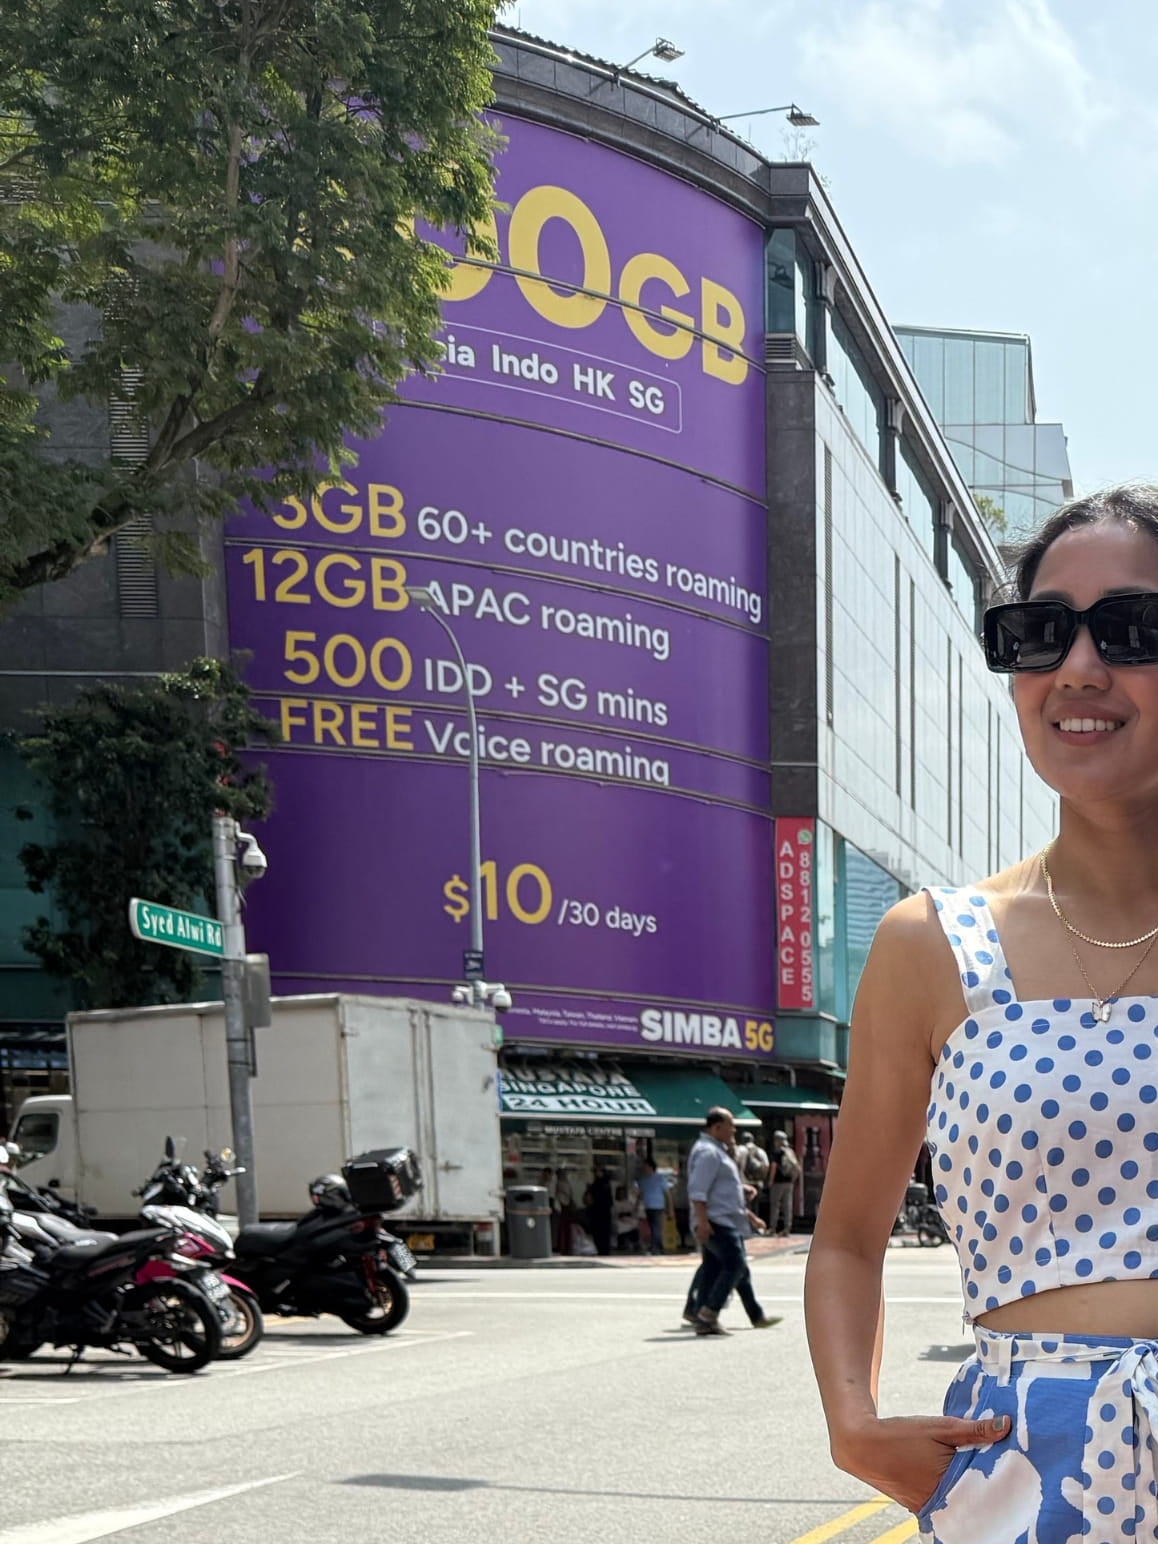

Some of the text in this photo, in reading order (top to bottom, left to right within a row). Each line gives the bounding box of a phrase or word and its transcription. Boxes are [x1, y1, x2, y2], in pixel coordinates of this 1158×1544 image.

[492, 344, 558, 384] Indo
[573, 363, 615, 401] HK
[629, 381, 664, 414] SG
[242, 548, 410, 611] 12GB
[541, 604, 670, 661] roaming
[417, 506, 492, 545] 60+
[504, 527, 659, 582] countries
[666, 563, 762, 623] roaming
[284, 630, 413, 691] 500
[424, 658, 492, 697] IDD
[538, 673, 588, 710] SG
[597, 688, 668, 726] mins
[280, 698, 670, 786] FREE Voice roaming
[141, 905, 222, 947] Syed Alwi Rd
[443, 860, 658, 937] $10 /30 days
[779, 841, 796, 985] ADSPACE
[799, 851, 812, 923] 8812
[640, 1008, 774, 1051] SIMBA 5G
